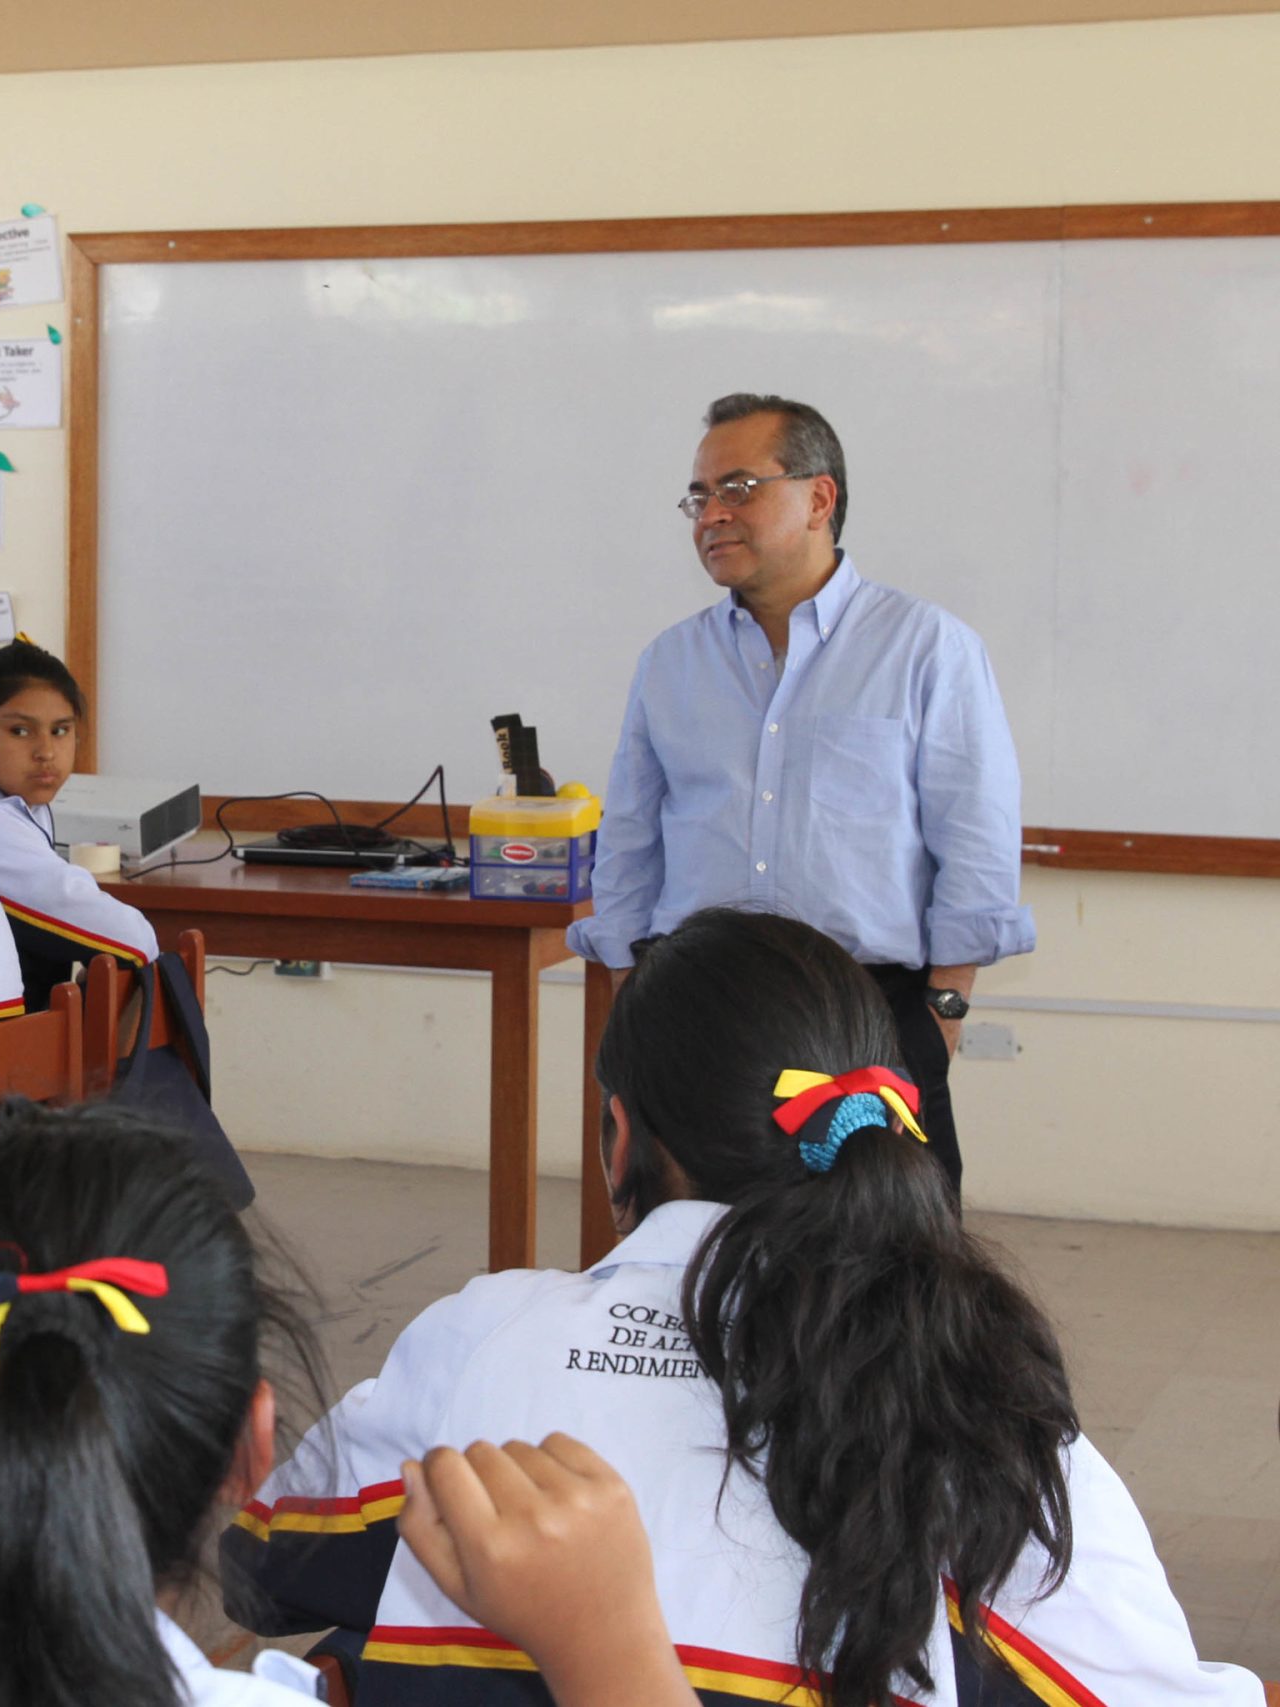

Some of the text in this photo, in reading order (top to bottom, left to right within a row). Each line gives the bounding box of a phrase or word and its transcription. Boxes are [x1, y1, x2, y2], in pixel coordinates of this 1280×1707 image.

[3, 345, 35, 358] Taker
[609, 1303, 688, 1333] COLE
[609, 1326, 695, 1352] DE ALT
[566, 1348, 711, 1379] RENDIMIEN
